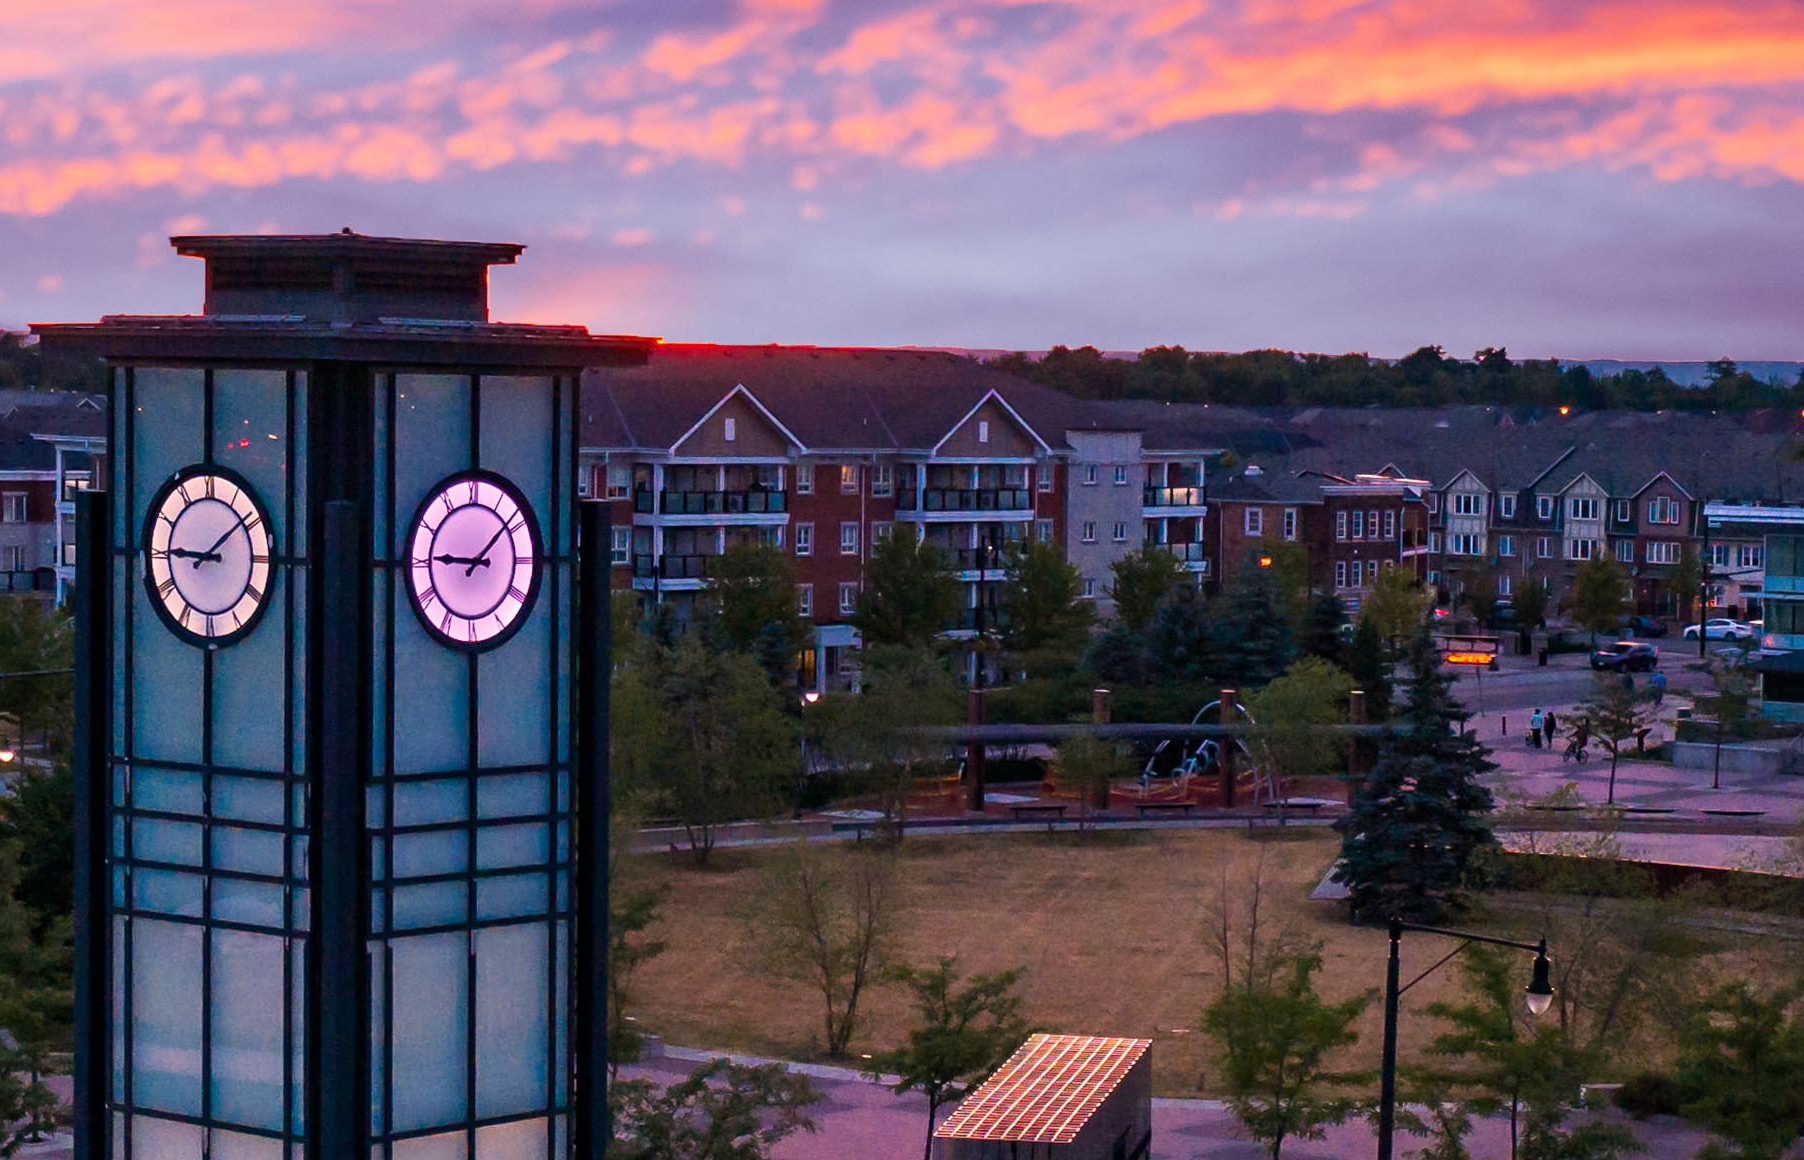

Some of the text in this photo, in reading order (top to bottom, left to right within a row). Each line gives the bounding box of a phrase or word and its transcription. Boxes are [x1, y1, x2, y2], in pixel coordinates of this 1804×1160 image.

[177, 484, 193, 507] XI
[230, 488, 240, 507] I
[439, 491, 455, 514] XI
[494, 492, 505, 512] I
[158, 510, 175, 528] X
[247, 517, 262, 531] II
[419, 519, 436, 537] X
[510, 519, 526, 534] II
[151, 547, 170, 559] IX
[252, 555, 269, 564] III
[412, 556, 430, 568] IX
[515, 556, 533, 565] III
[205, 614, 215, 637] VI
[232, 610, 243, 629] V
[494, 612, 505, 631] V
[468, 619, 478, 642] VI
